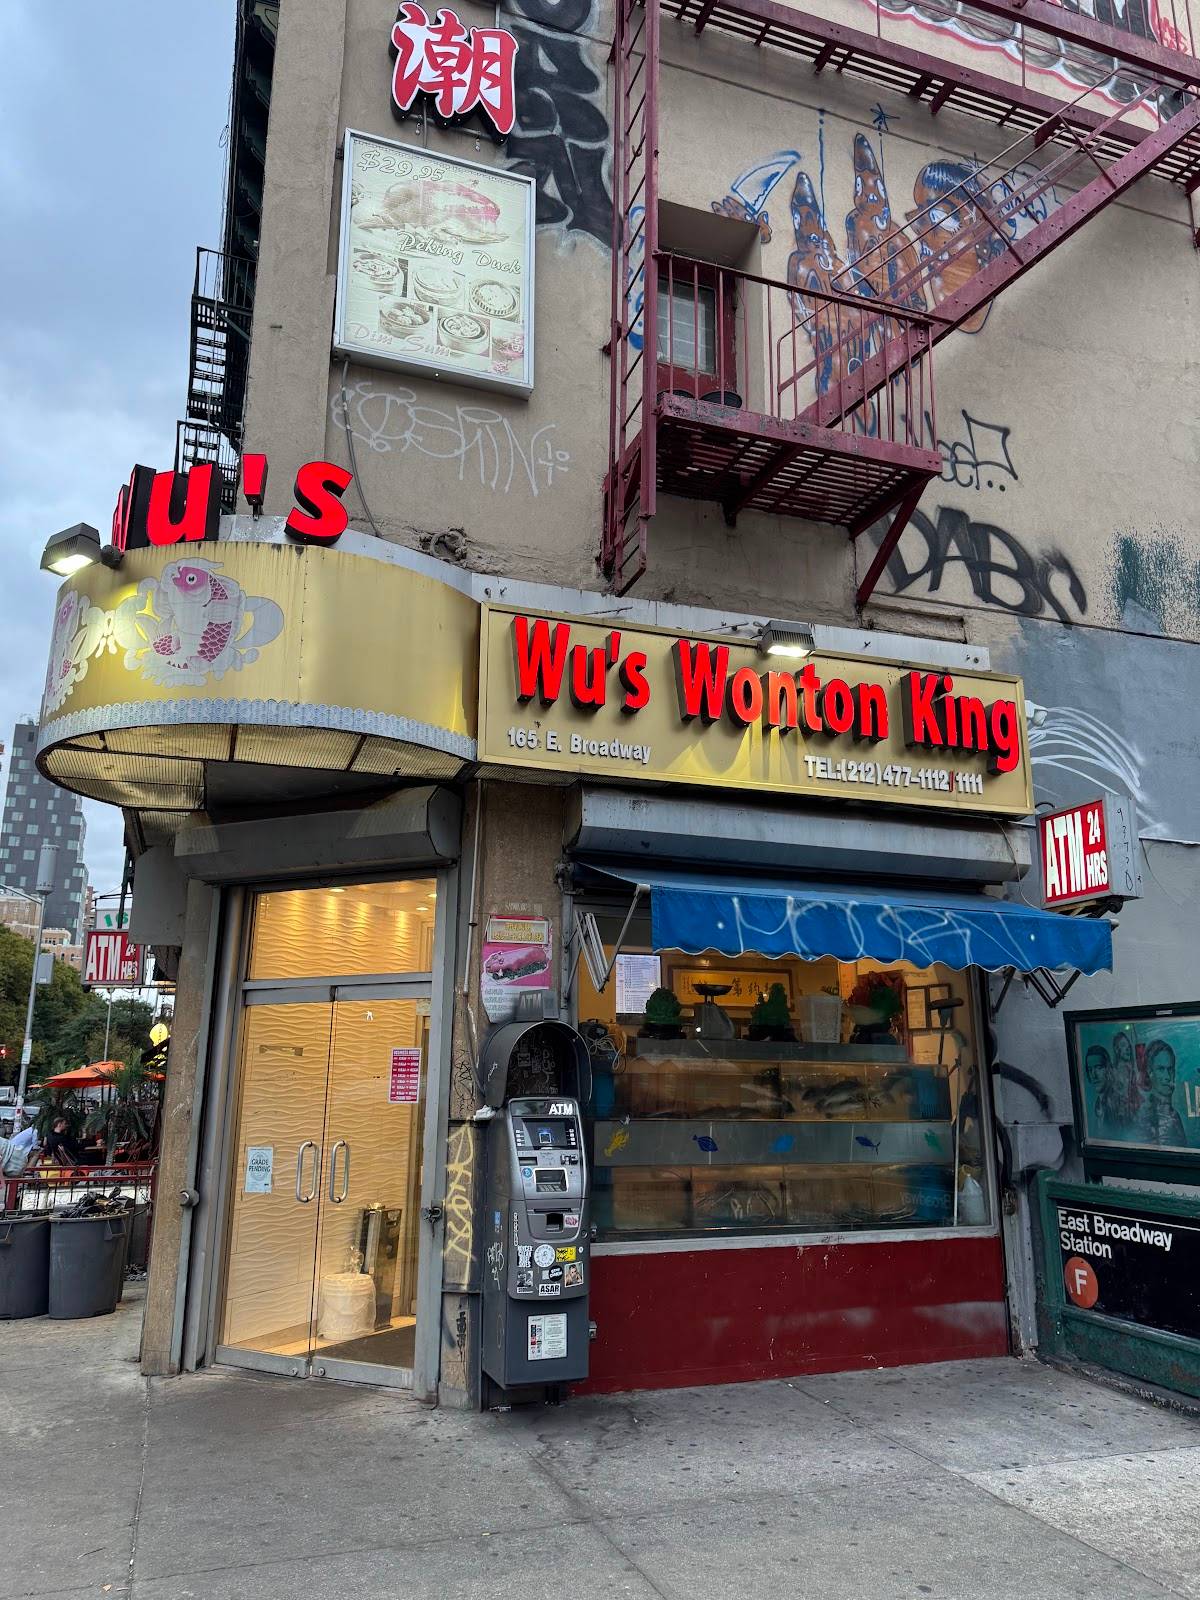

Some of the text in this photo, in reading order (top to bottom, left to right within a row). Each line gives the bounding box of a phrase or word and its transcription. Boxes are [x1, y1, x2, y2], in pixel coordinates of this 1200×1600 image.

[392, 1, 518, 135] 潮
[357, 149, 446, 182] $29.95
[397, 230, 522, 275] Peking Duck
[511, 615, 1019, 775] Wu's Wonton King
[507, 725, 652, 764] 165 E. Broadway
[1087, 808, 1101, 845] 24
[1045, 810, 1087, 898] ATM
[1085, 849, 1108, 889] HRS
[85, 935, 122, 981] ATM
[520, 993, 542, 1009] ATM
[548, 1103, 573, 1115] ATM
[1057, 1209, 1173, 1251] East Broadway
[1060, 1231, 1113, 1259] Station
[1074, 1268, 1088, 1295] F
